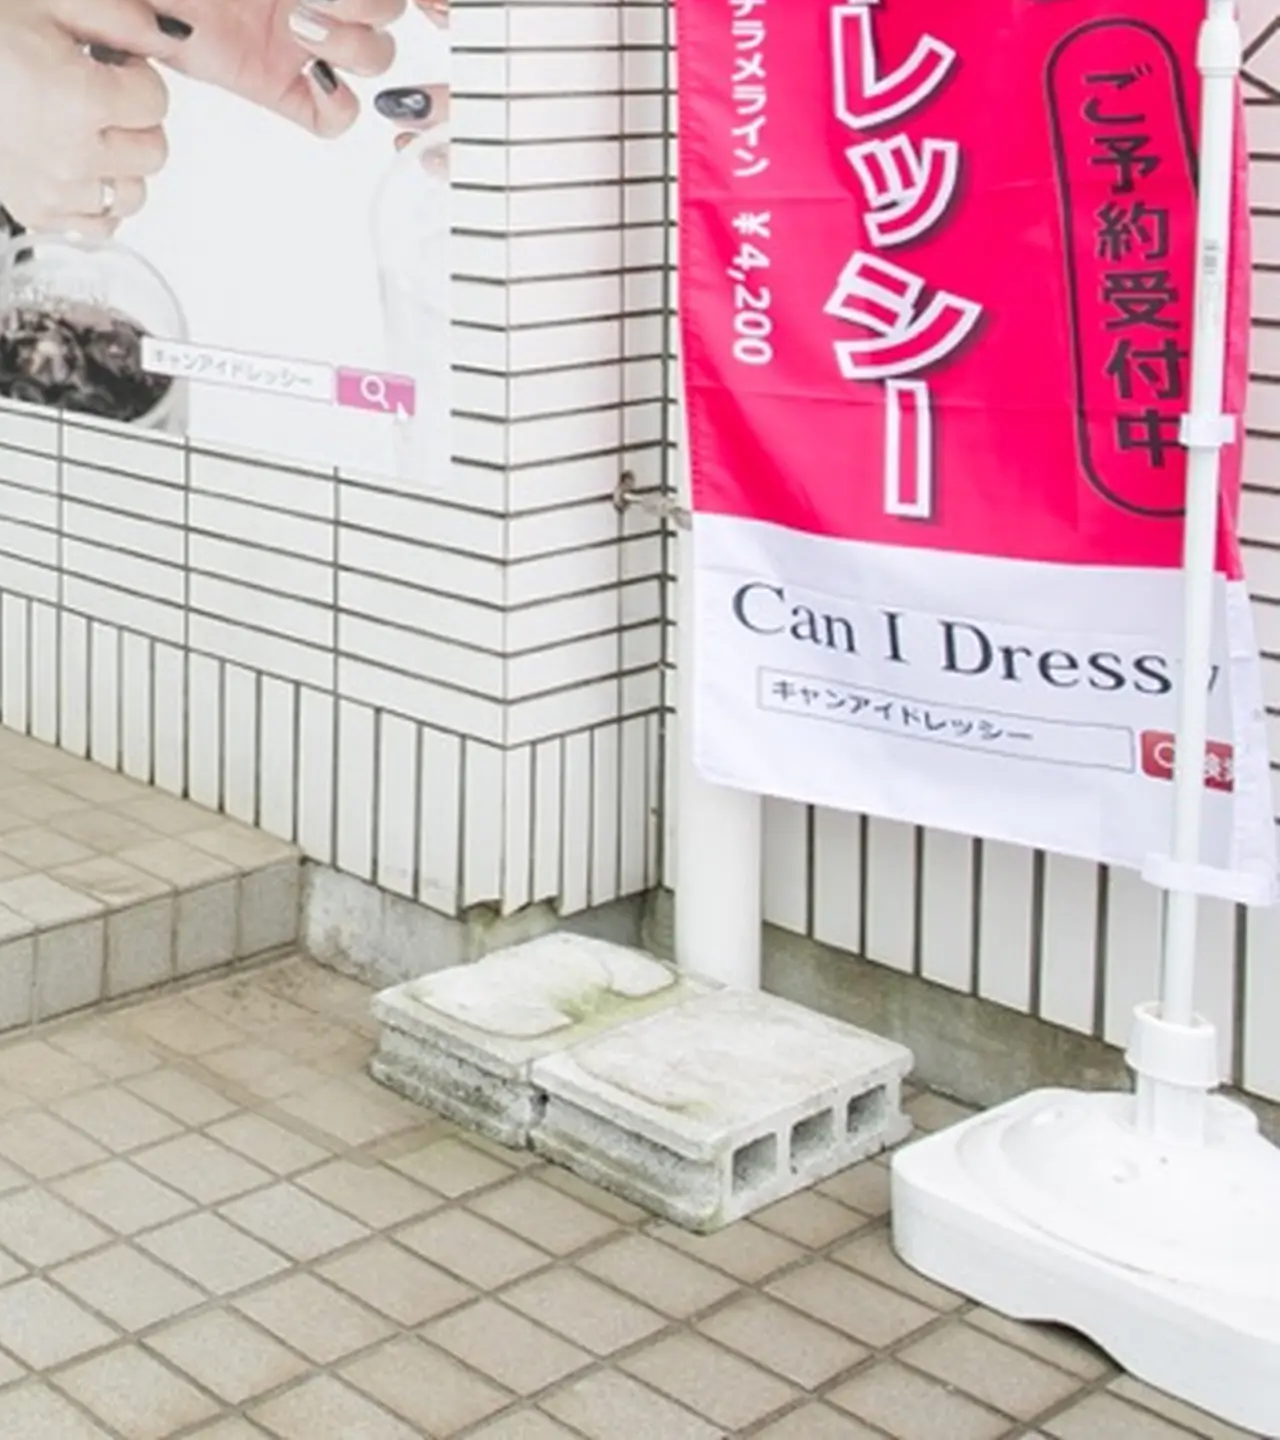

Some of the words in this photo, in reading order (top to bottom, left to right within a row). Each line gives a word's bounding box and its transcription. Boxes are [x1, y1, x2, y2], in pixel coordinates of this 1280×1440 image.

[1080, 62, 1189, 470] ご予約受付中
[731, 580, 860, 656] Can
[881, 610, 910, 664] I
[939, 619, 1220, 696] Dress
[770, 679, 1034, 741] キャンアイドレッシー
